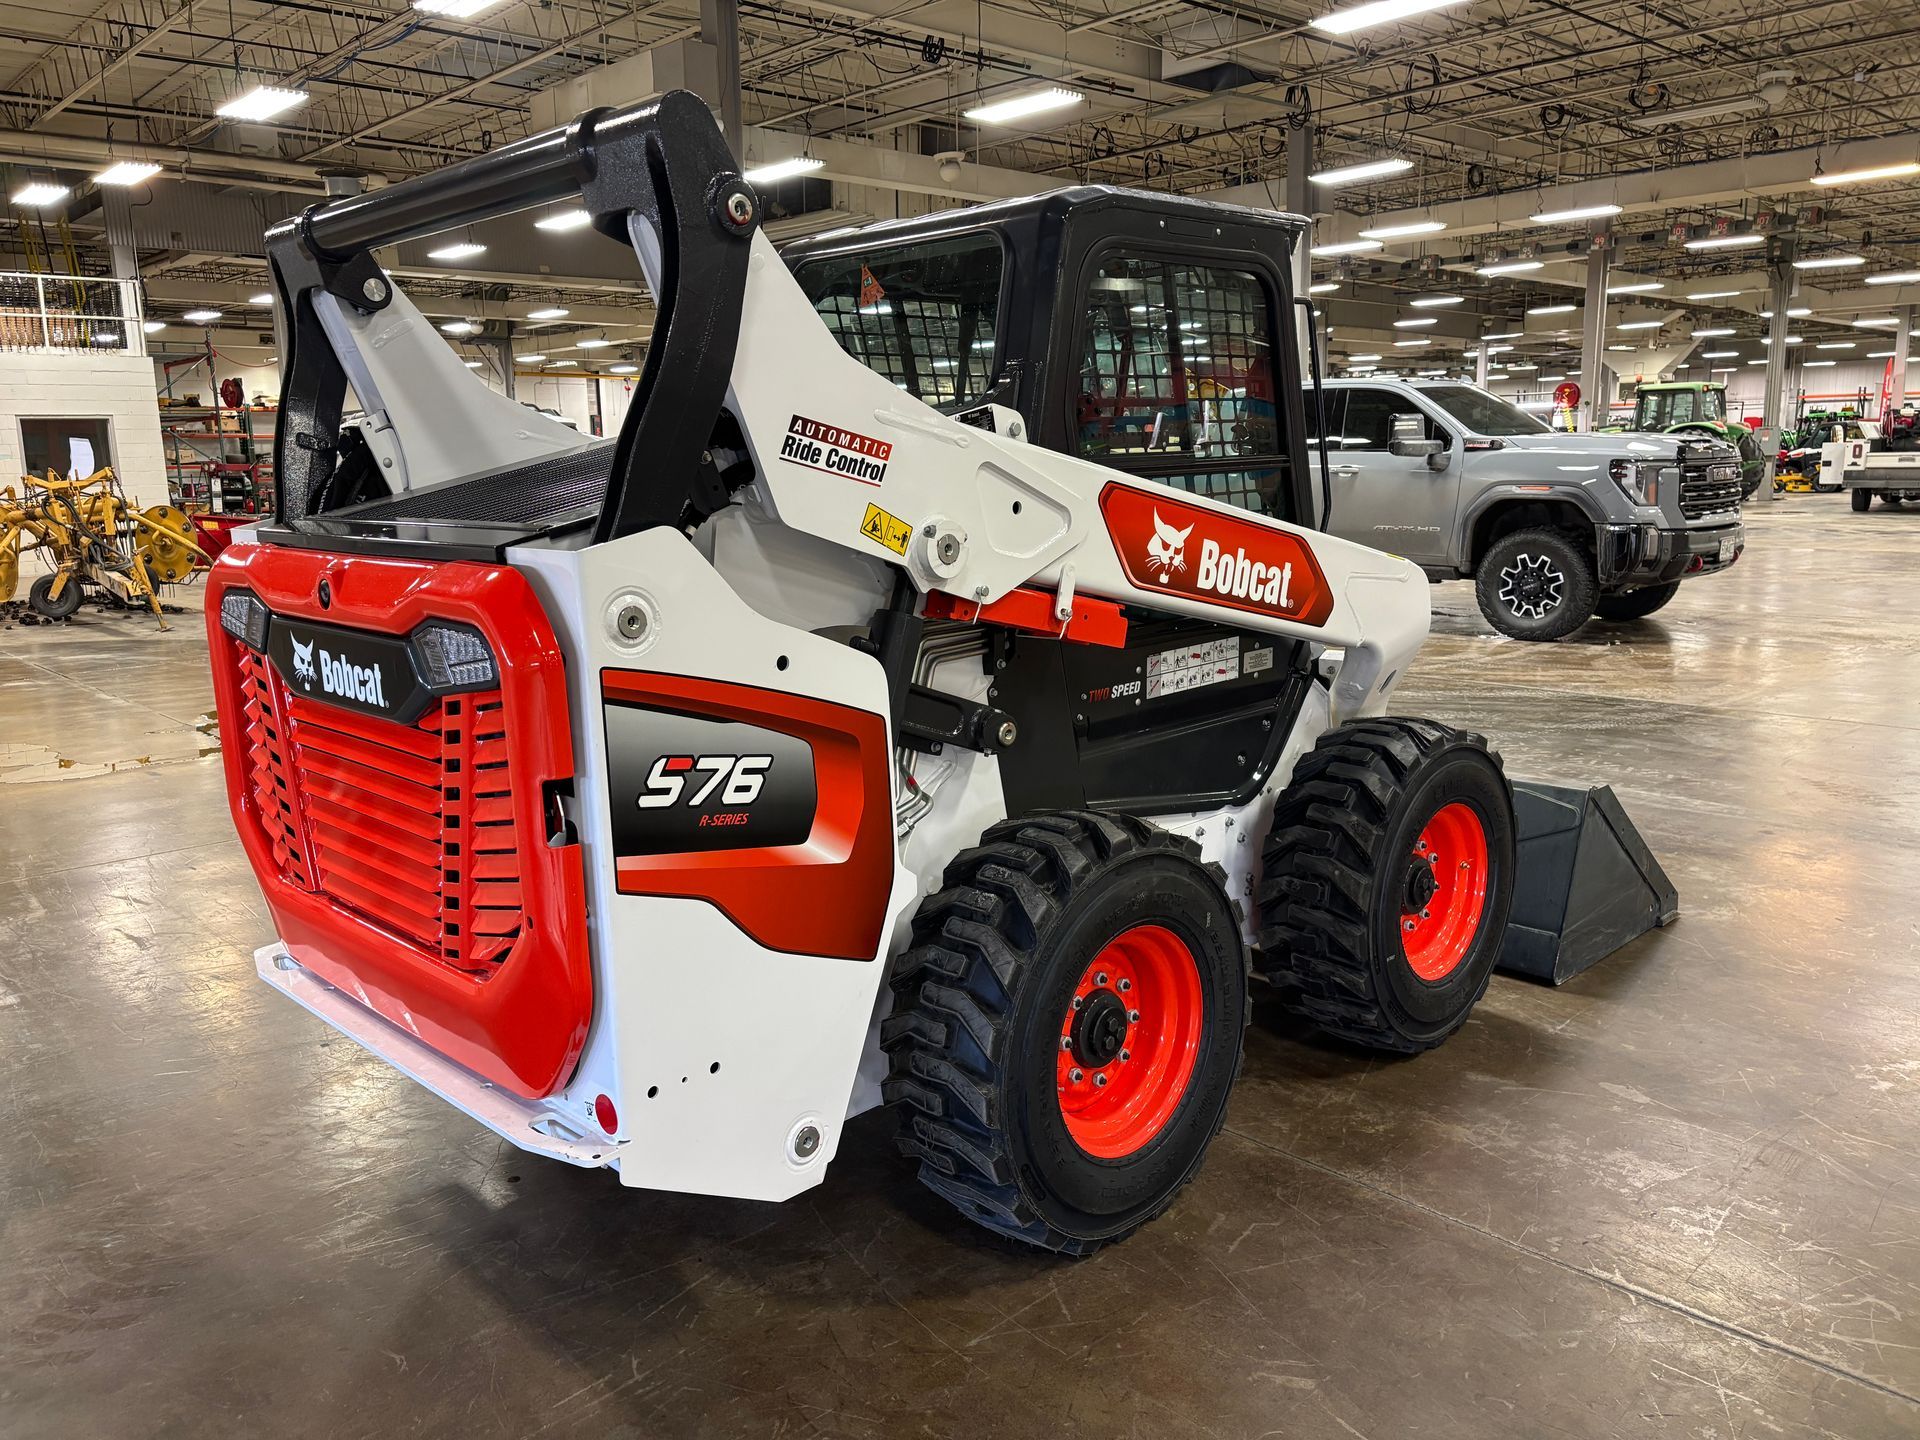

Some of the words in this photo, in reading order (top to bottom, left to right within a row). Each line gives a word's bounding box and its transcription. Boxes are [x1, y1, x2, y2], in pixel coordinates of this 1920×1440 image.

[1673, 227, 1685, 235] 103
[780, 434, 822, 464] Ride
[825, 448, 888, 482] Control
[792, 419, 888, 458] AUTOMATIC
[1197, 538, 1292, 608] Bobcat
[319, 649, 385, 708] Bobcat
[1089, 687, 1110, 704] TWO
[1111, 680, 1141, 699] SPEED
[636, 755, 773, 809] S76
[699, 813, 750, 827] R-SERIES
